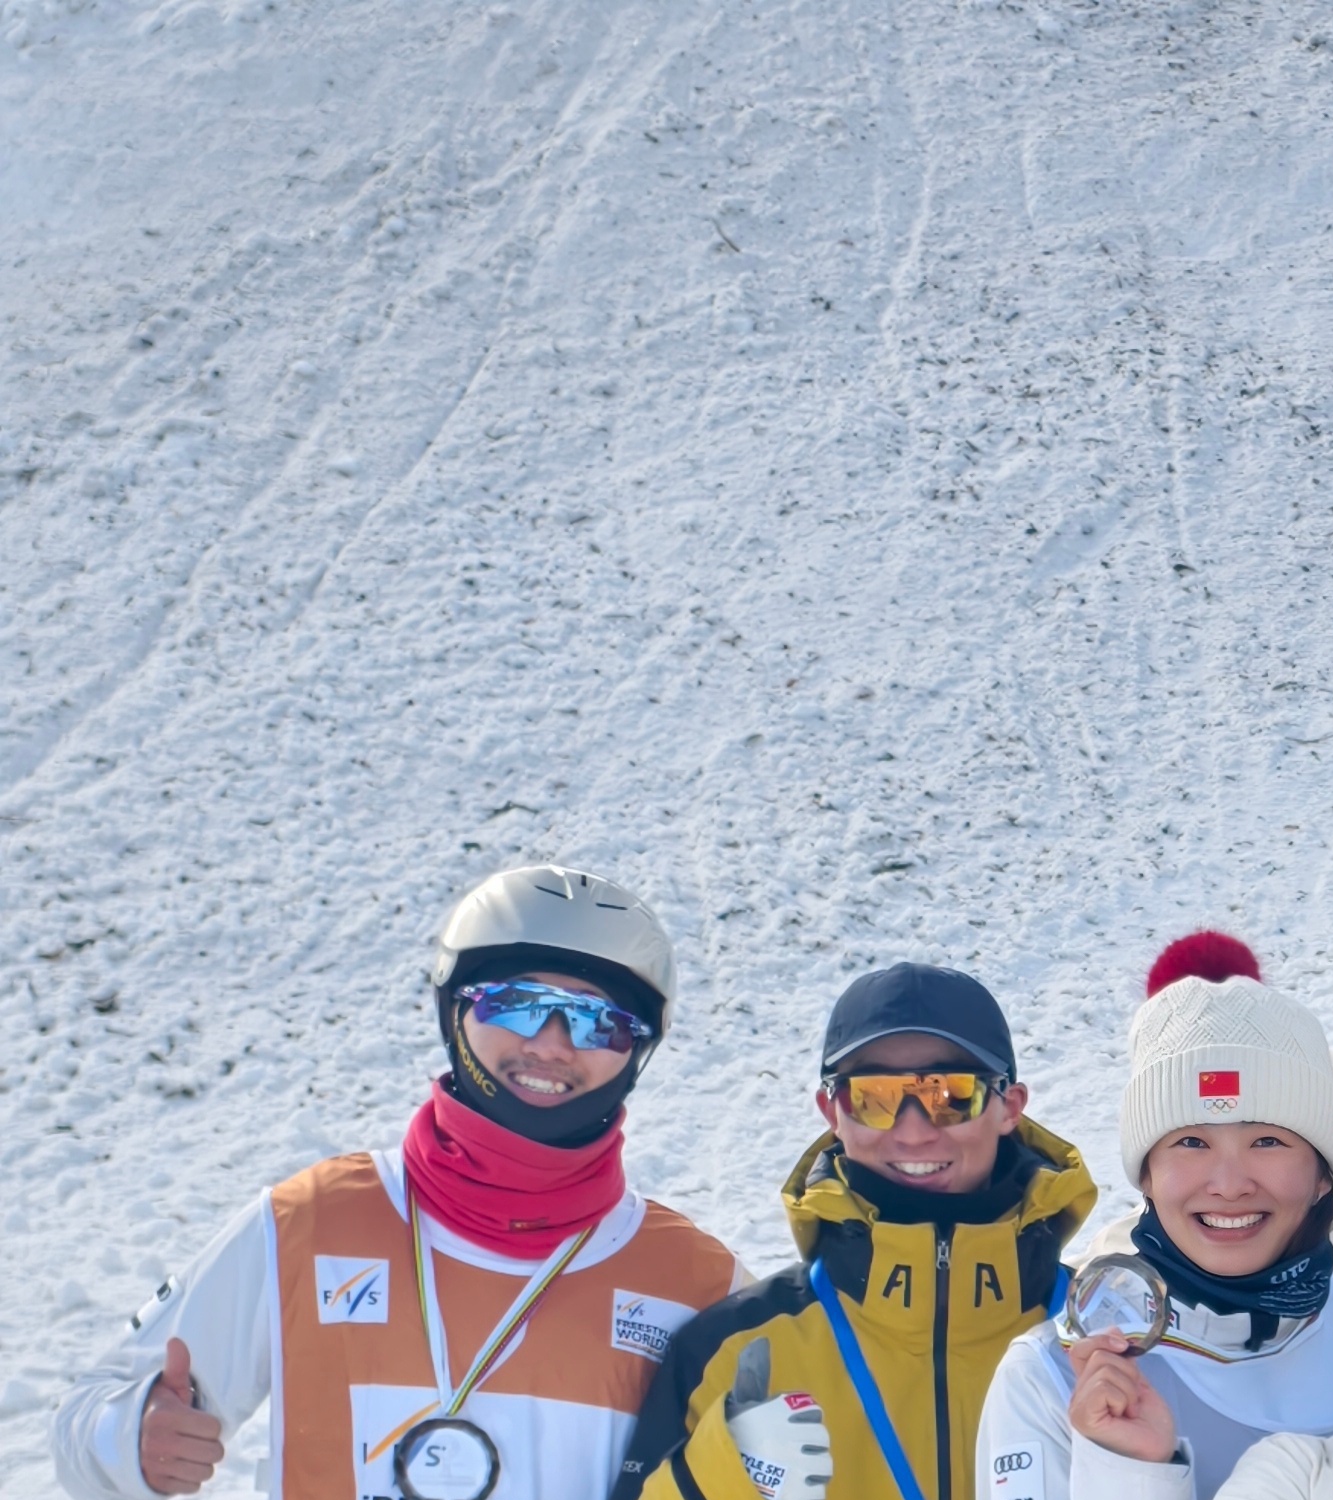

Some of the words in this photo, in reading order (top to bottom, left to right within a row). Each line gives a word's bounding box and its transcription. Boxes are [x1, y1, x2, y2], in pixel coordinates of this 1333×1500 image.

[323, 1289, 381, 1306] FIS
[616, 1318, 672, 1341] FREESTYL
[615, 1327, 666, 1351] WORLD
[765, 1463, 785, 1478] SKI
[752, 1472, 782, 1489] CUP
